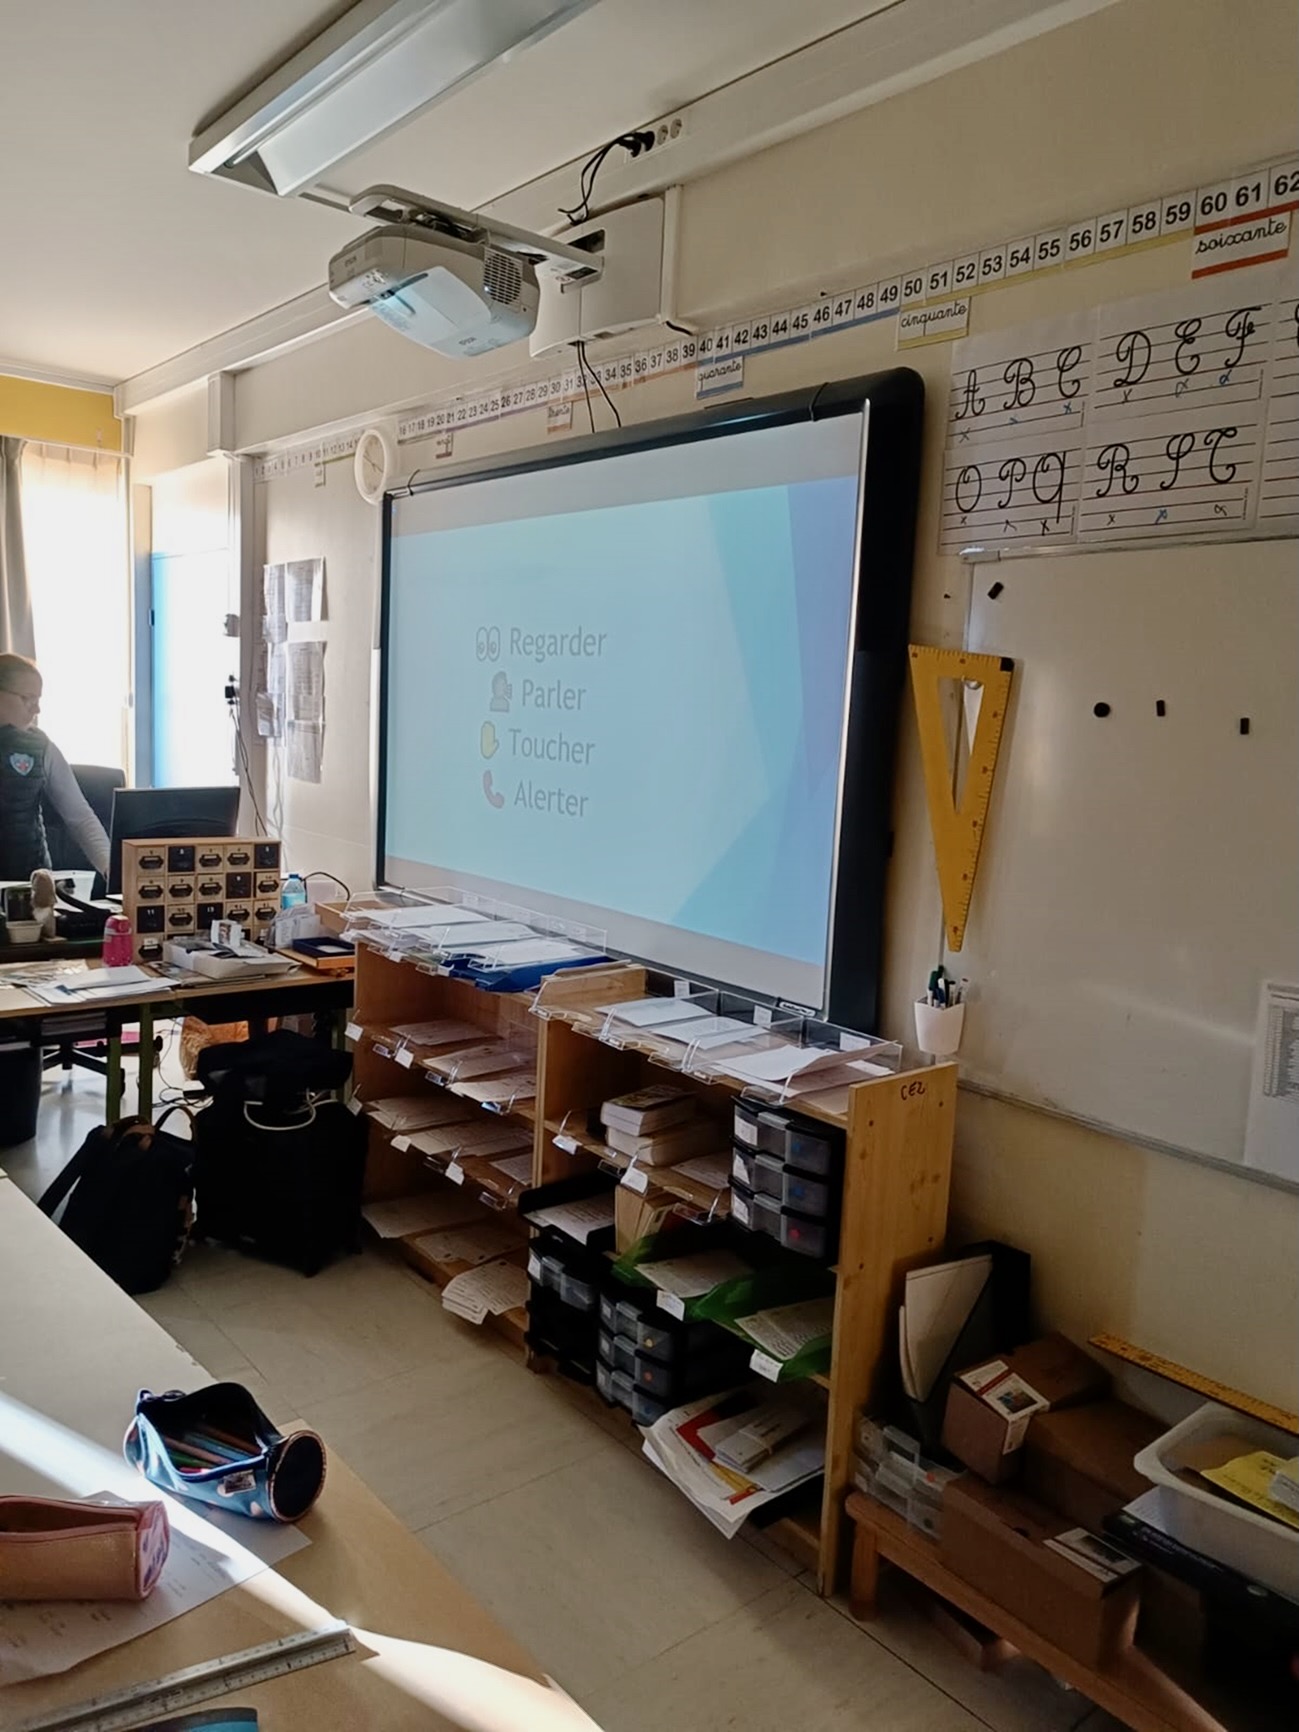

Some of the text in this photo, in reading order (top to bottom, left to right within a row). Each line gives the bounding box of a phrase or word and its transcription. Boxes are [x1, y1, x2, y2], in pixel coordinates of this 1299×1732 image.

[1195, 218, 1287, 254] soixante
[436, 414, 444, 426] 20
[446, 412, 455, 424] 21
[457, 409, 466, 421] 22
[468, 405, 477, 418] 23
[479, 402, 489, 415] 24
[490, 400, 499, 412] 25
[500, 396, 511, 408] 26
[513, 393, 524, 405] 27
[525, 389, 536, 402] 28
[538, 385, 548, 399] 29
[551, 381, 561, 395] 30
[563, 379, 573, 391] 31
[604, 368, 616, 381] 34
[620, 363, 632, 378] 35
[635, 358, 648, 373] 36
[650, 353, 663, 368] 37
[666, 348, 679, 364] 38
[682, 343, 696, 359] 39
[699, 338, 713, 352] 40
[716, 335, 730, 350] 41
[734, 329, 749, 345] 42
[752, 324, 768, 340] 43
[772, 320, 788, 335] 44
[792, 313, 809, 330] 45
[813, 306, 830, 323] 46
[834, 300, 852, 316] 47
[857, 292, 874, 309] 48
[880, 285, 898, 303] 49
[903, 277, 923, 297] 50
[929, 271, 948, 290] 51
[955, 263, 976, 283] 52
[981, 255, 1003, 276] 53
[1009, 247, 1031, 268] 54
[1038, 238, 1060, 260] 55
[1069, 229, 1092, 251] 56
[1100, 219, 1124, 243] 57
[1132, 211, 1156, 234] 58
[1165, 201, 1191, 225] 59
[1200, 192, 1228, 215] 60
[1235, 182, 1261, 207] 61
[1274, 170, 1299, 196] 62
[901, 300, 968, 336] cinquante
[1113, 330, 1151, 387] D
[1174, 318, 1202, 376] E
[1224, 306, 1262, 368] F
[697, 360, 742, 391] quarante
[955, 345, 1082, 420] A B C
[1096, 427, 1237, 498] R S T
[955, 465, 982, 513] O
[997, 458, 1027, 509] P
[510, 625, 607, 663] Regarder
[522, 679, 587, 711] Parler
[508, 728, 596, 765] Toucher
[514, 779, 589, 817] Alerter
